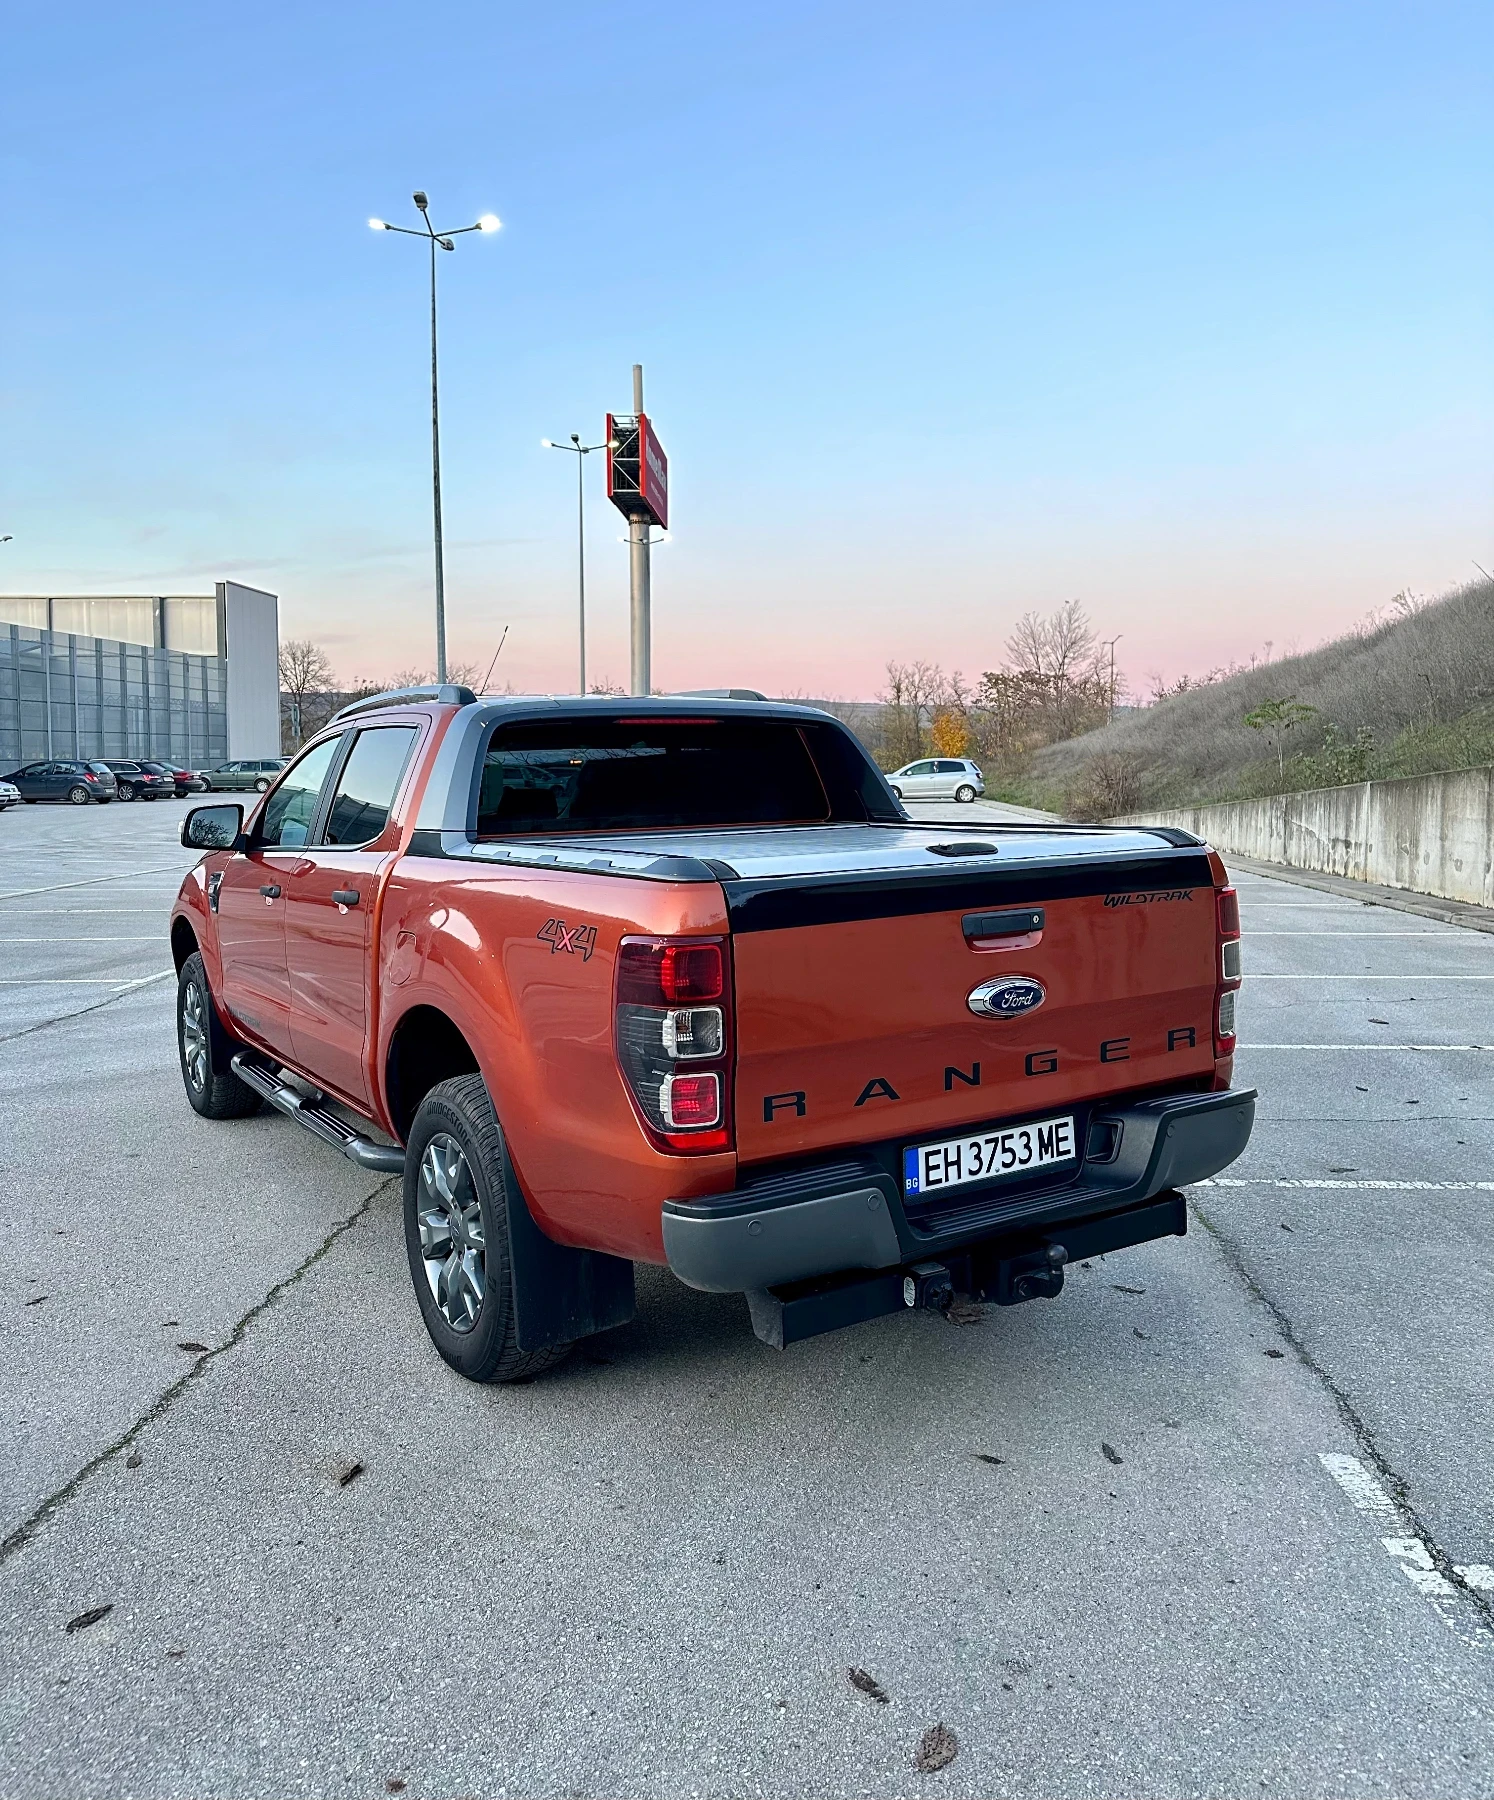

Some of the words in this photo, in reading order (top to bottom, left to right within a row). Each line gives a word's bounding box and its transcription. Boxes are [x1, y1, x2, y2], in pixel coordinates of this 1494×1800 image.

[1103, 889, 1193, 908] WILDTRAK
[1001, 988, 1034, 1008] Ford
[763, 1026, 1197, 1123] RANGER
[924, 1144, 962, 1187] EH
[968, 1131, 1033, 1176] 3753
[1037, 1121, 1072, 1161] ME
[906, 1178, 918, 1190] BG
